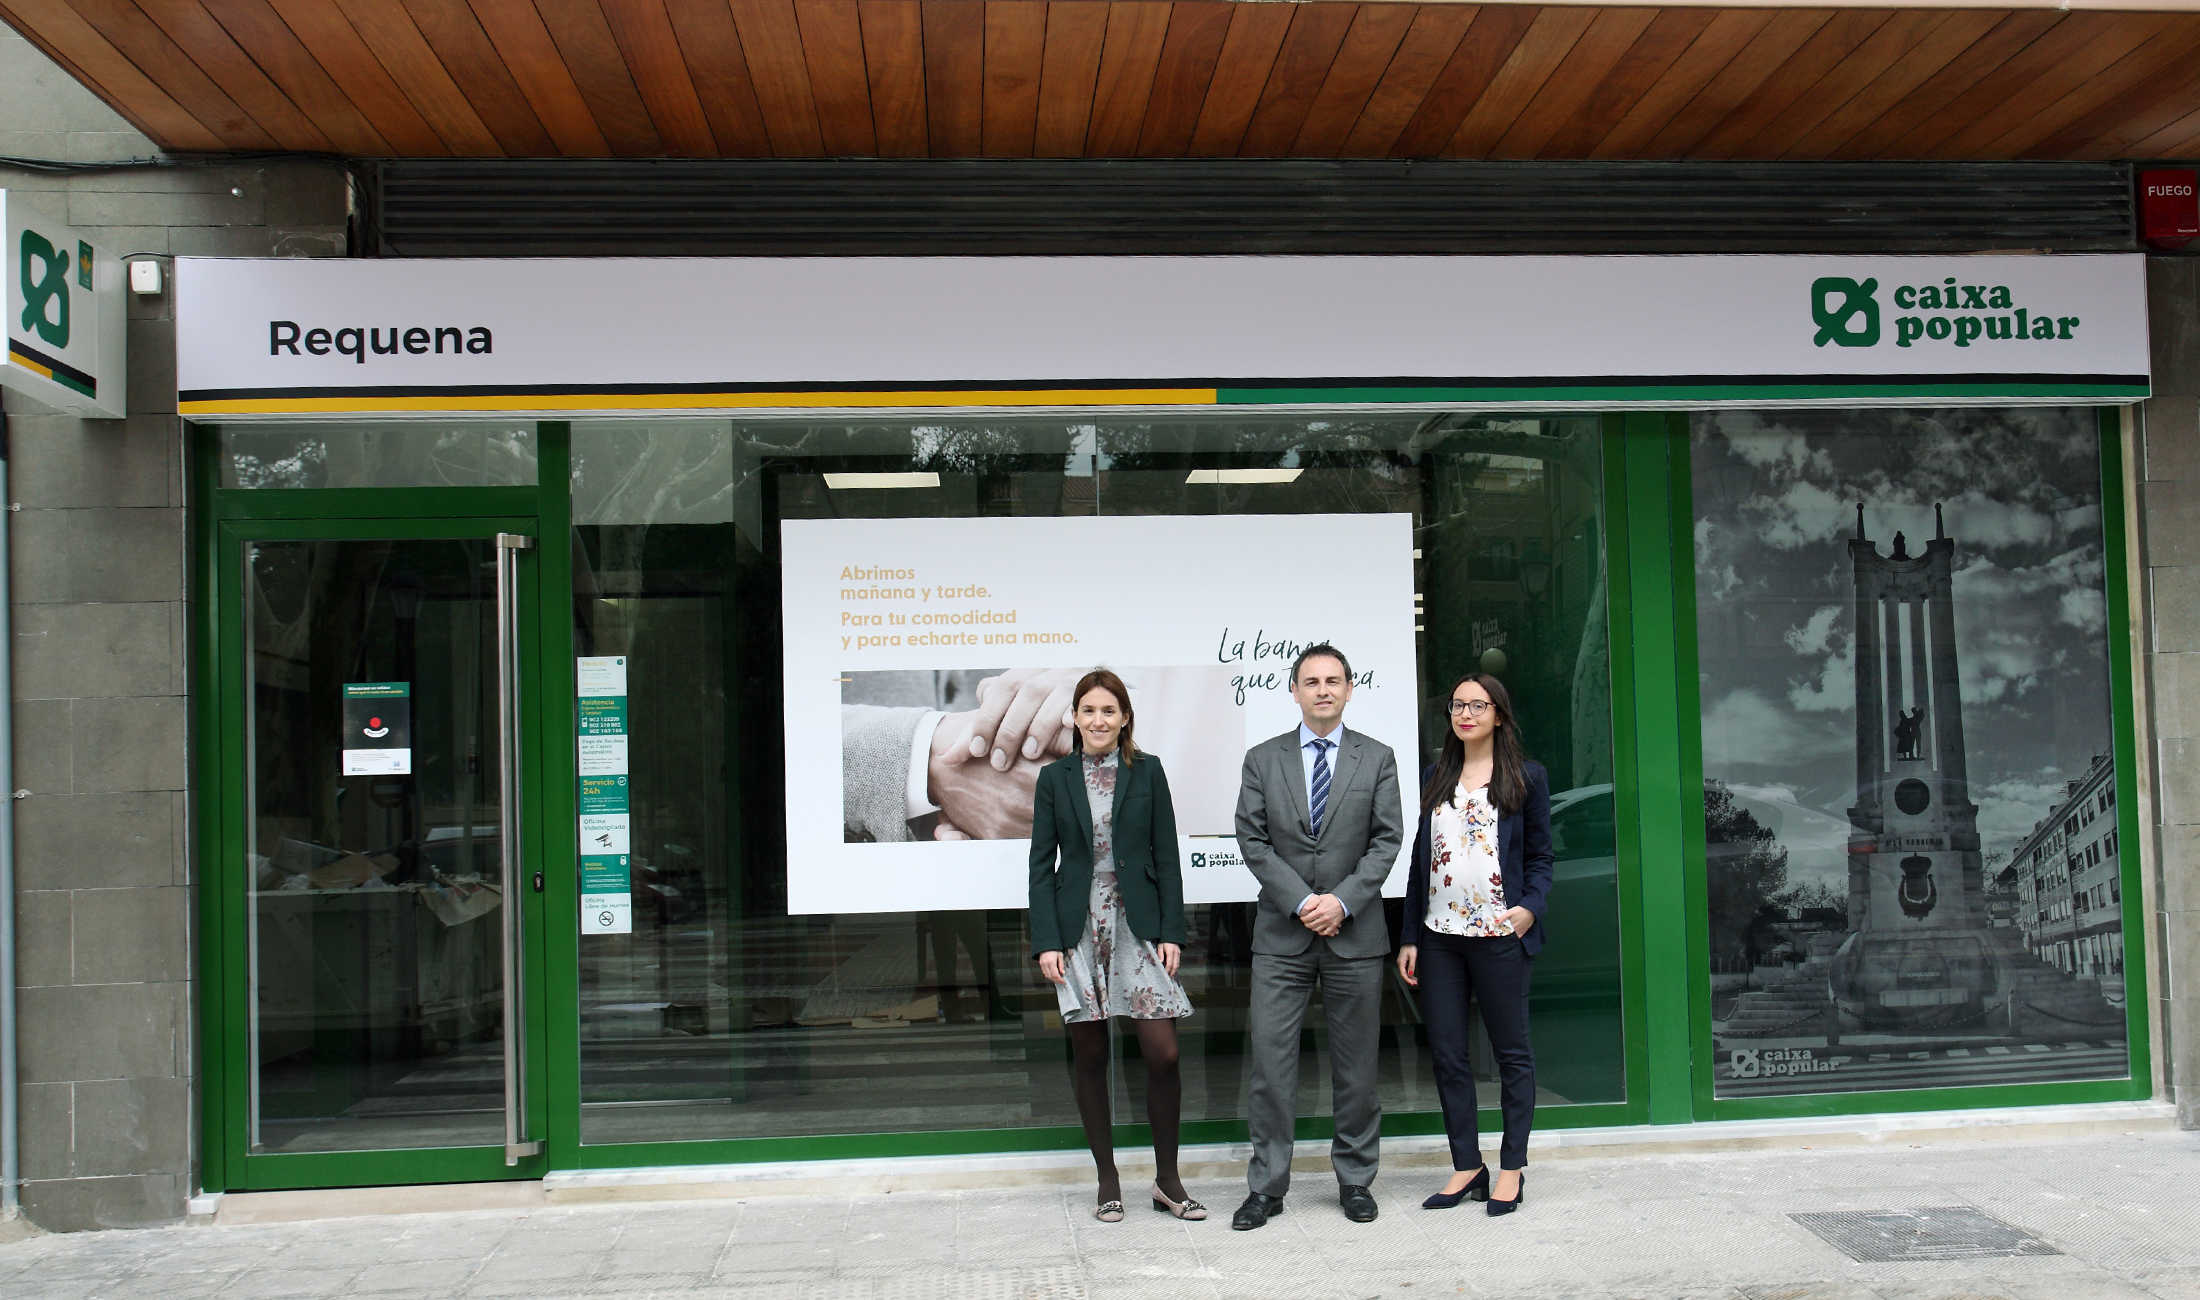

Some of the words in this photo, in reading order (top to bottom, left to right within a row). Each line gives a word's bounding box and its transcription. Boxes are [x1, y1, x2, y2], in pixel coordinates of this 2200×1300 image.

[2148, 185, 2192, 196] FUEGO
[1894, 277, 2014, 309] caixa
[1894, 307, 2081, 347] popular
[269, 320, 493, 364] Requena
[840, 564, 916, 581] Abrimos
[840, 585, 916, 600] mañana
[921, 587, 931, 602] y
[937, 583, 993, 599] tarde.
[841, 611, 883, 626] Para
[889, 611, 906, 626] tu
[911, 609, 1018, 625] comodidad
[841, 635, 851, 650] y
[857, 633, 902, 650] para
[907, 631, 979, 647] echarte
[983, 631, 1018, 645] una
[1023, 630, 1079, 645] mano.
[1218, 627, 1246, 663] La
[1231, 671, 1281, 706] que
[583, 787, 601, 795] 24h
[1209, 858, 1245, 867] popula
[1764, 1048, 1812, 1061] caixa
[1763, 1060, 1840, 1076] popular
